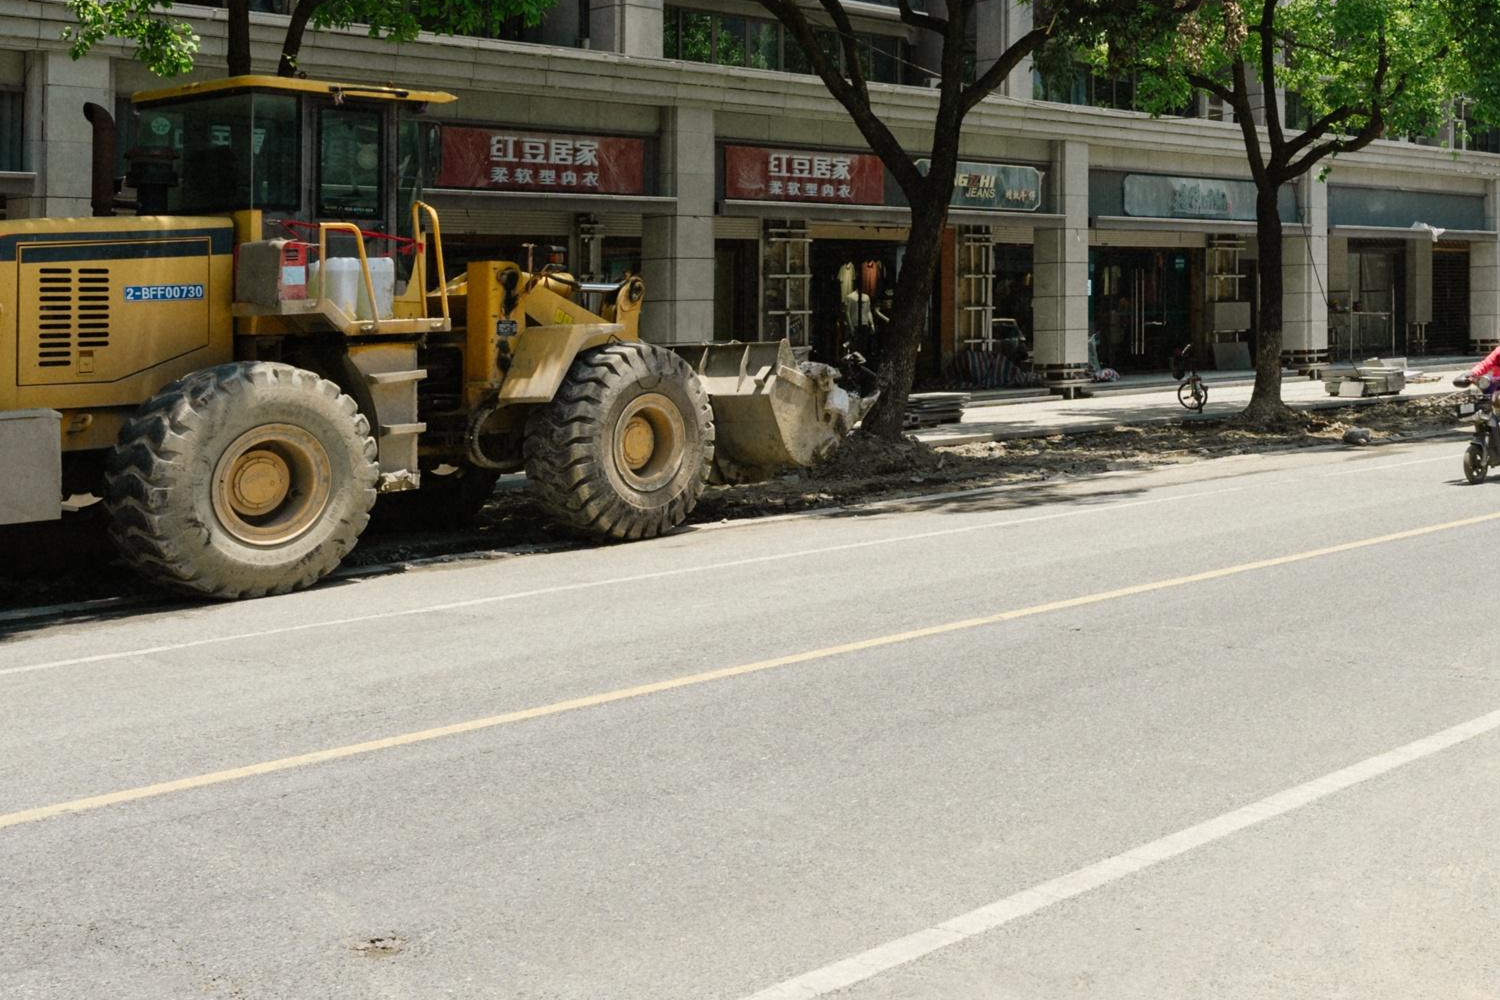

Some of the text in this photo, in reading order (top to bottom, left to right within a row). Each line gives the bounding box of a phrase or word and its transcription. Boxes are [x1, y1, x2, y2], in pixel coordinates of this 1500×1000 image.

[489, 135, 600, 167] 红豆居家
[767, 153, 851, 179] 红豆居家
[490, 167, 600, 187] 柔软型内衣
[767, 180, 851, 198] 柔软型内衣
[965, 187, 996, 199] JEANS
[125, 286, 203, 300] 2-BFF00730
